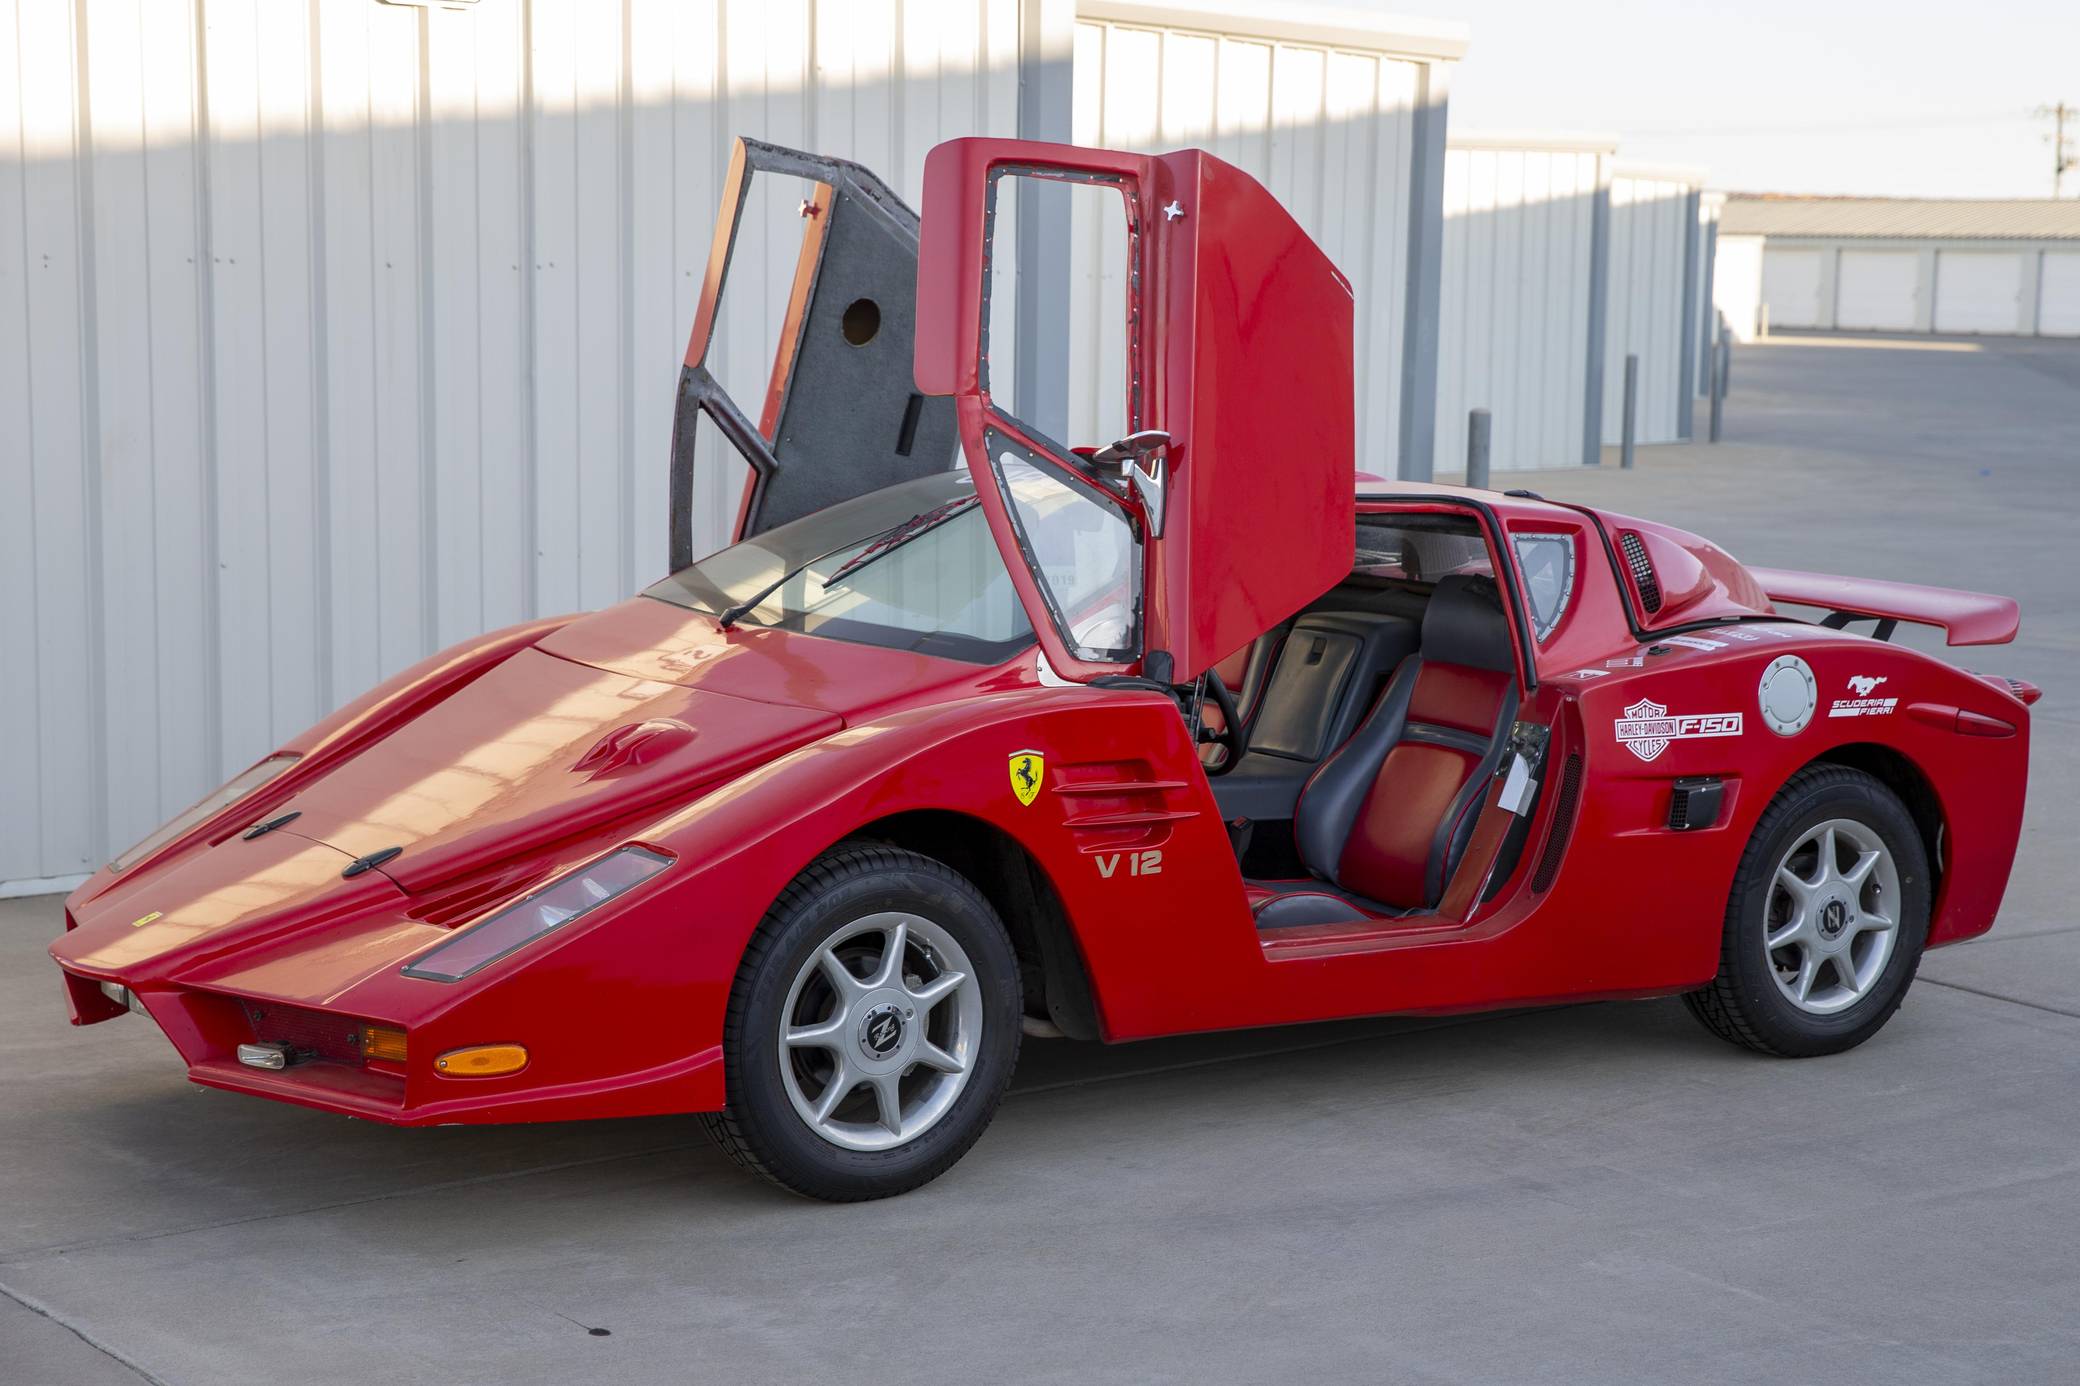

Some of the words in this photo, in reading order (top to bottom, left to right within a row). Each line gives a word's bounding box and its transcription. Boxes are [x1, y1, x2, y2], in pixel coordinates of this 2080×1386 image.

[1832, 699, 1883, 708] SCUDERIA
[1631, 705, 1660, 719] MOTOR
[1859, 707, 1893, 715] FIERRI
[1619, 722, 1674, 736] HARLEY-DAVIDSON
[1680, 717, 1739, 734] F-150
[1633, 739, 1662, 757] CYCLES
[1094, 853, 1120, 878] V
[1130, 850, 1162, 876] 12
